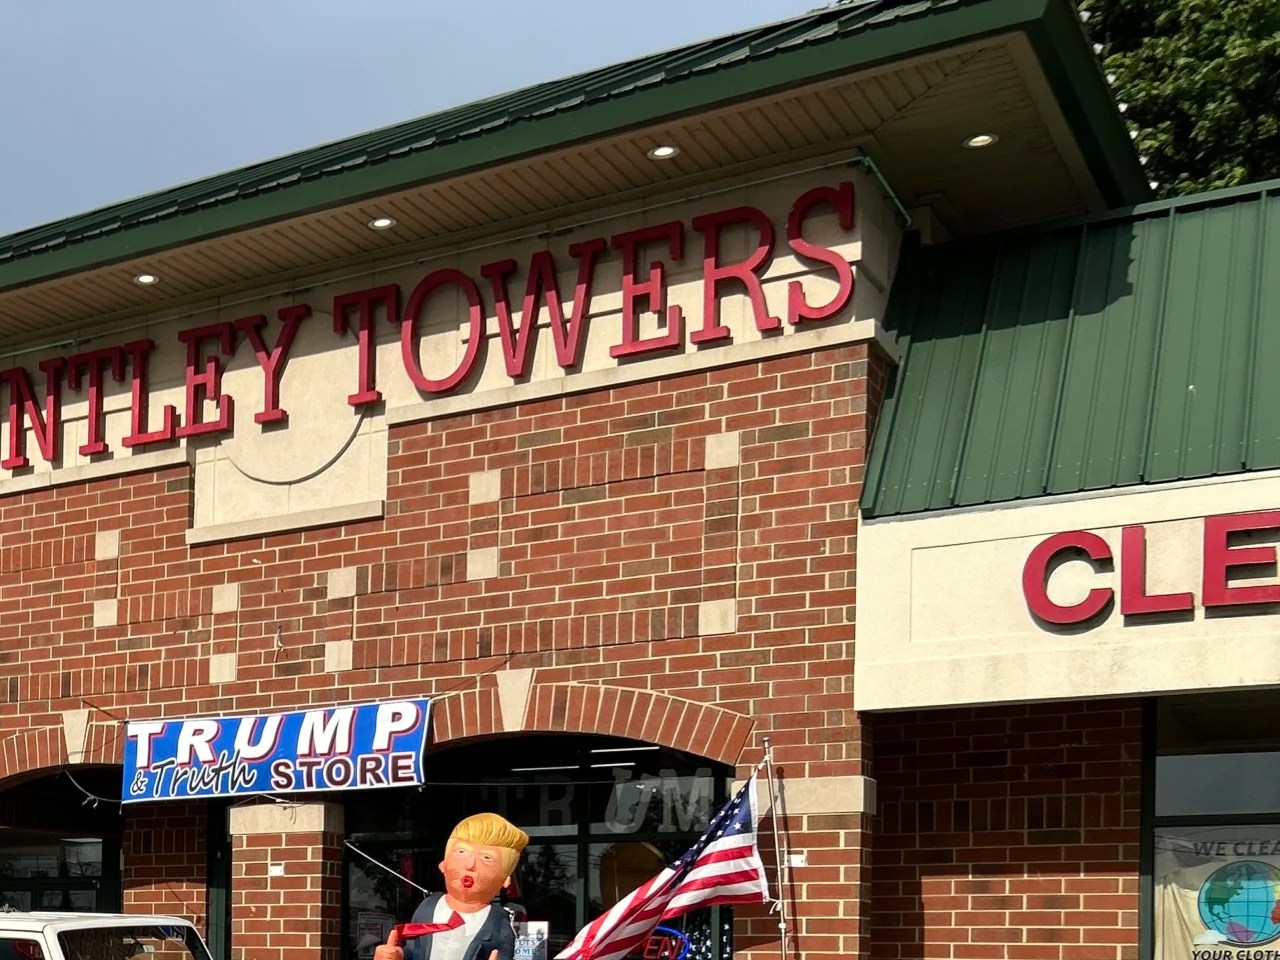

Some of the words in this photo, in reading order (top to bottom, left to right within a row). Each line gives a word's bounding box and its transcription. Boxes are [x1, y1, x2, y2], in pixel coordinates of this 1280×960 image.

[333, 181, 854, 406] TOWERS
[1022, 509, 1280, 624] CLE
[127, 702, 421, 770] TRUMP
[130, 769, 147, 796] &
[150, 749, 257, 798] Truth
[270, 751, 415, 791] STORE
[480, 767, 715, 834] TRUM
[1193, 842, 1226, 856] WE
[643, 936, 684, 960] EN
[1192, 950, 1232, 960] YOUR
